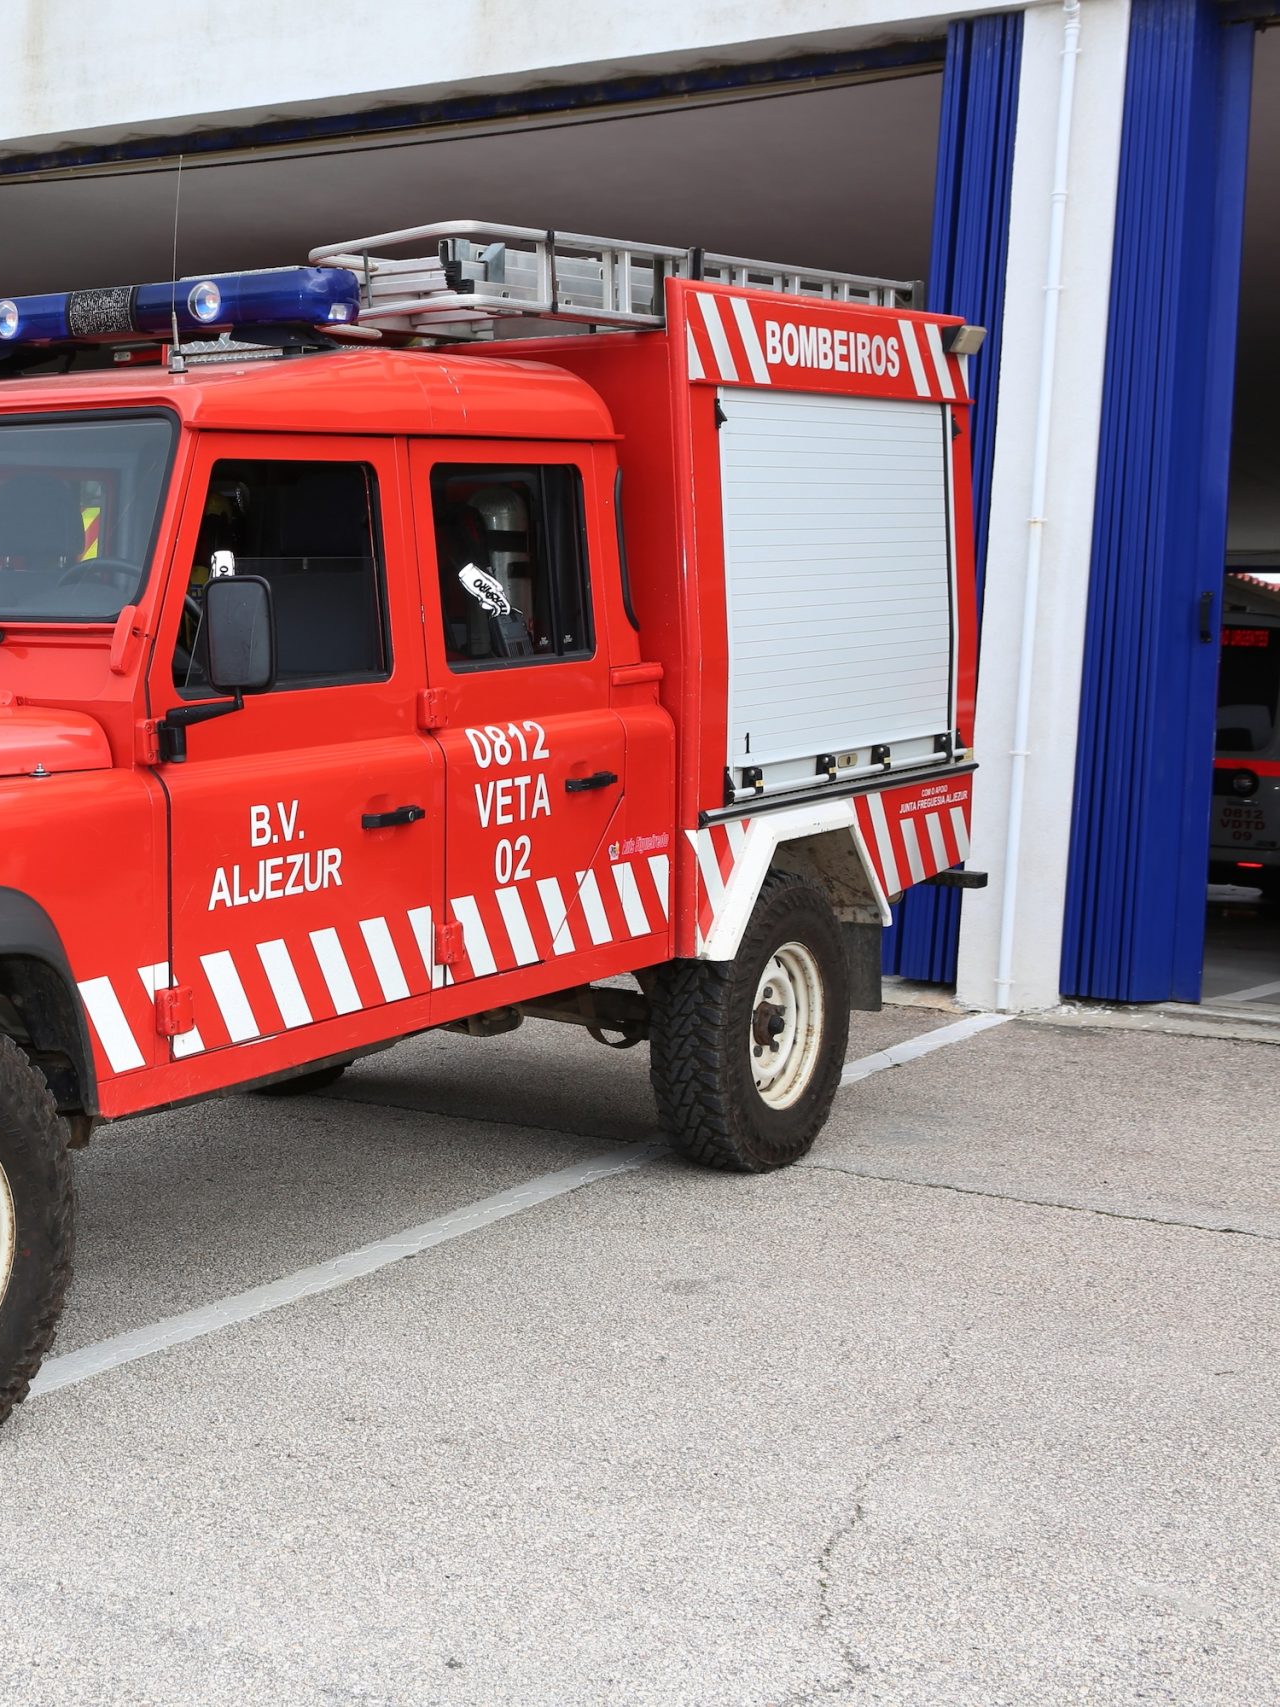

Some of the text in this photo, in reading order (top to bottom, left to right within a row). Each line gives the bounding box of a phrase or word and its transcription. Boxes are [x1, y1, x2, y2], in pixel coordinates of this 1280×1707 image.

[765, 320, 900, 377] BOMBEIROS
[464, 720, 550, 769] 0812
[744, 732, 750, 754] 1
[250, 800, 304, 848] B.V.
[474, 773, 552, 828] VETA
[899, 801, 917, 814] JUNTA
[1220, 818, 1265, 830] VDTD
[1223, 807, 1264, 820] 0812
[494, 835, 532, 885] 02
[1232, 831, 1253, 841] 09
[208, 847, 342, 911] ALJEZUR
